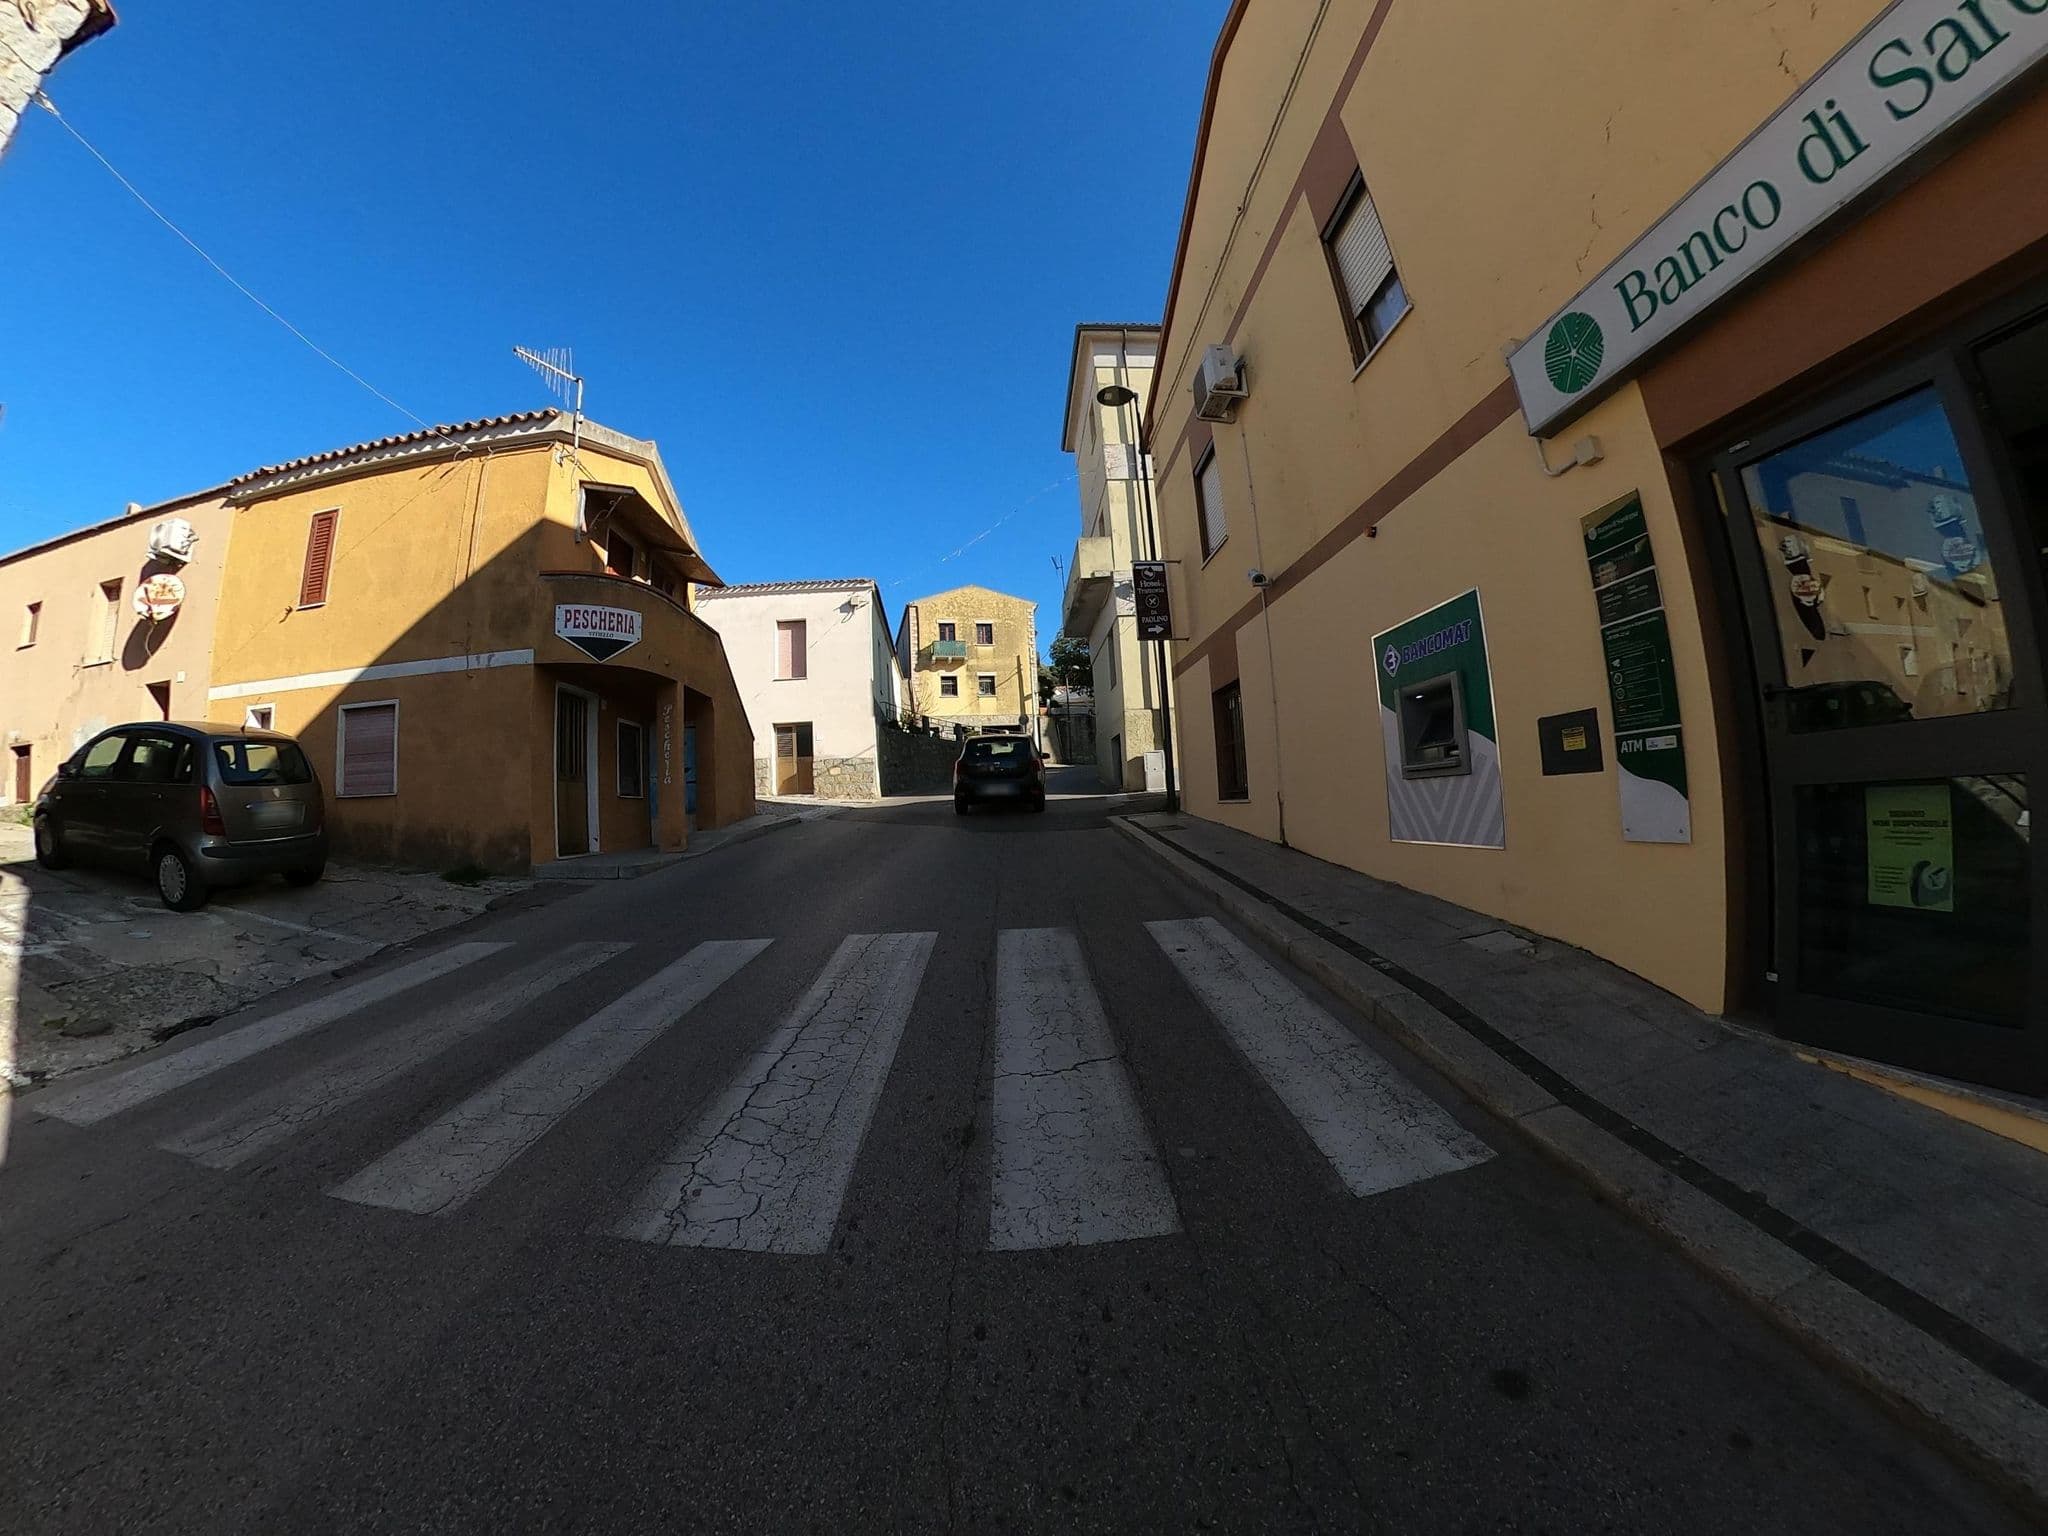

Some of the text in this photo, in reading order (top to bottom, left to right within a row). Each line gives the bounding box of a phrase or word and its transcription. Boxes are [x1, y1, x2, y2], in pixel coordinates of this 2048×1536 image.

[1612, 180, 1782, 333] Banco
[1796, 98, 1870, 185] di
[564, 609, 635, 634] PESCHERIA
[1401, 618, 1472, 665] BANCOMAT
[1621, 739, 1643, 754] ATM
